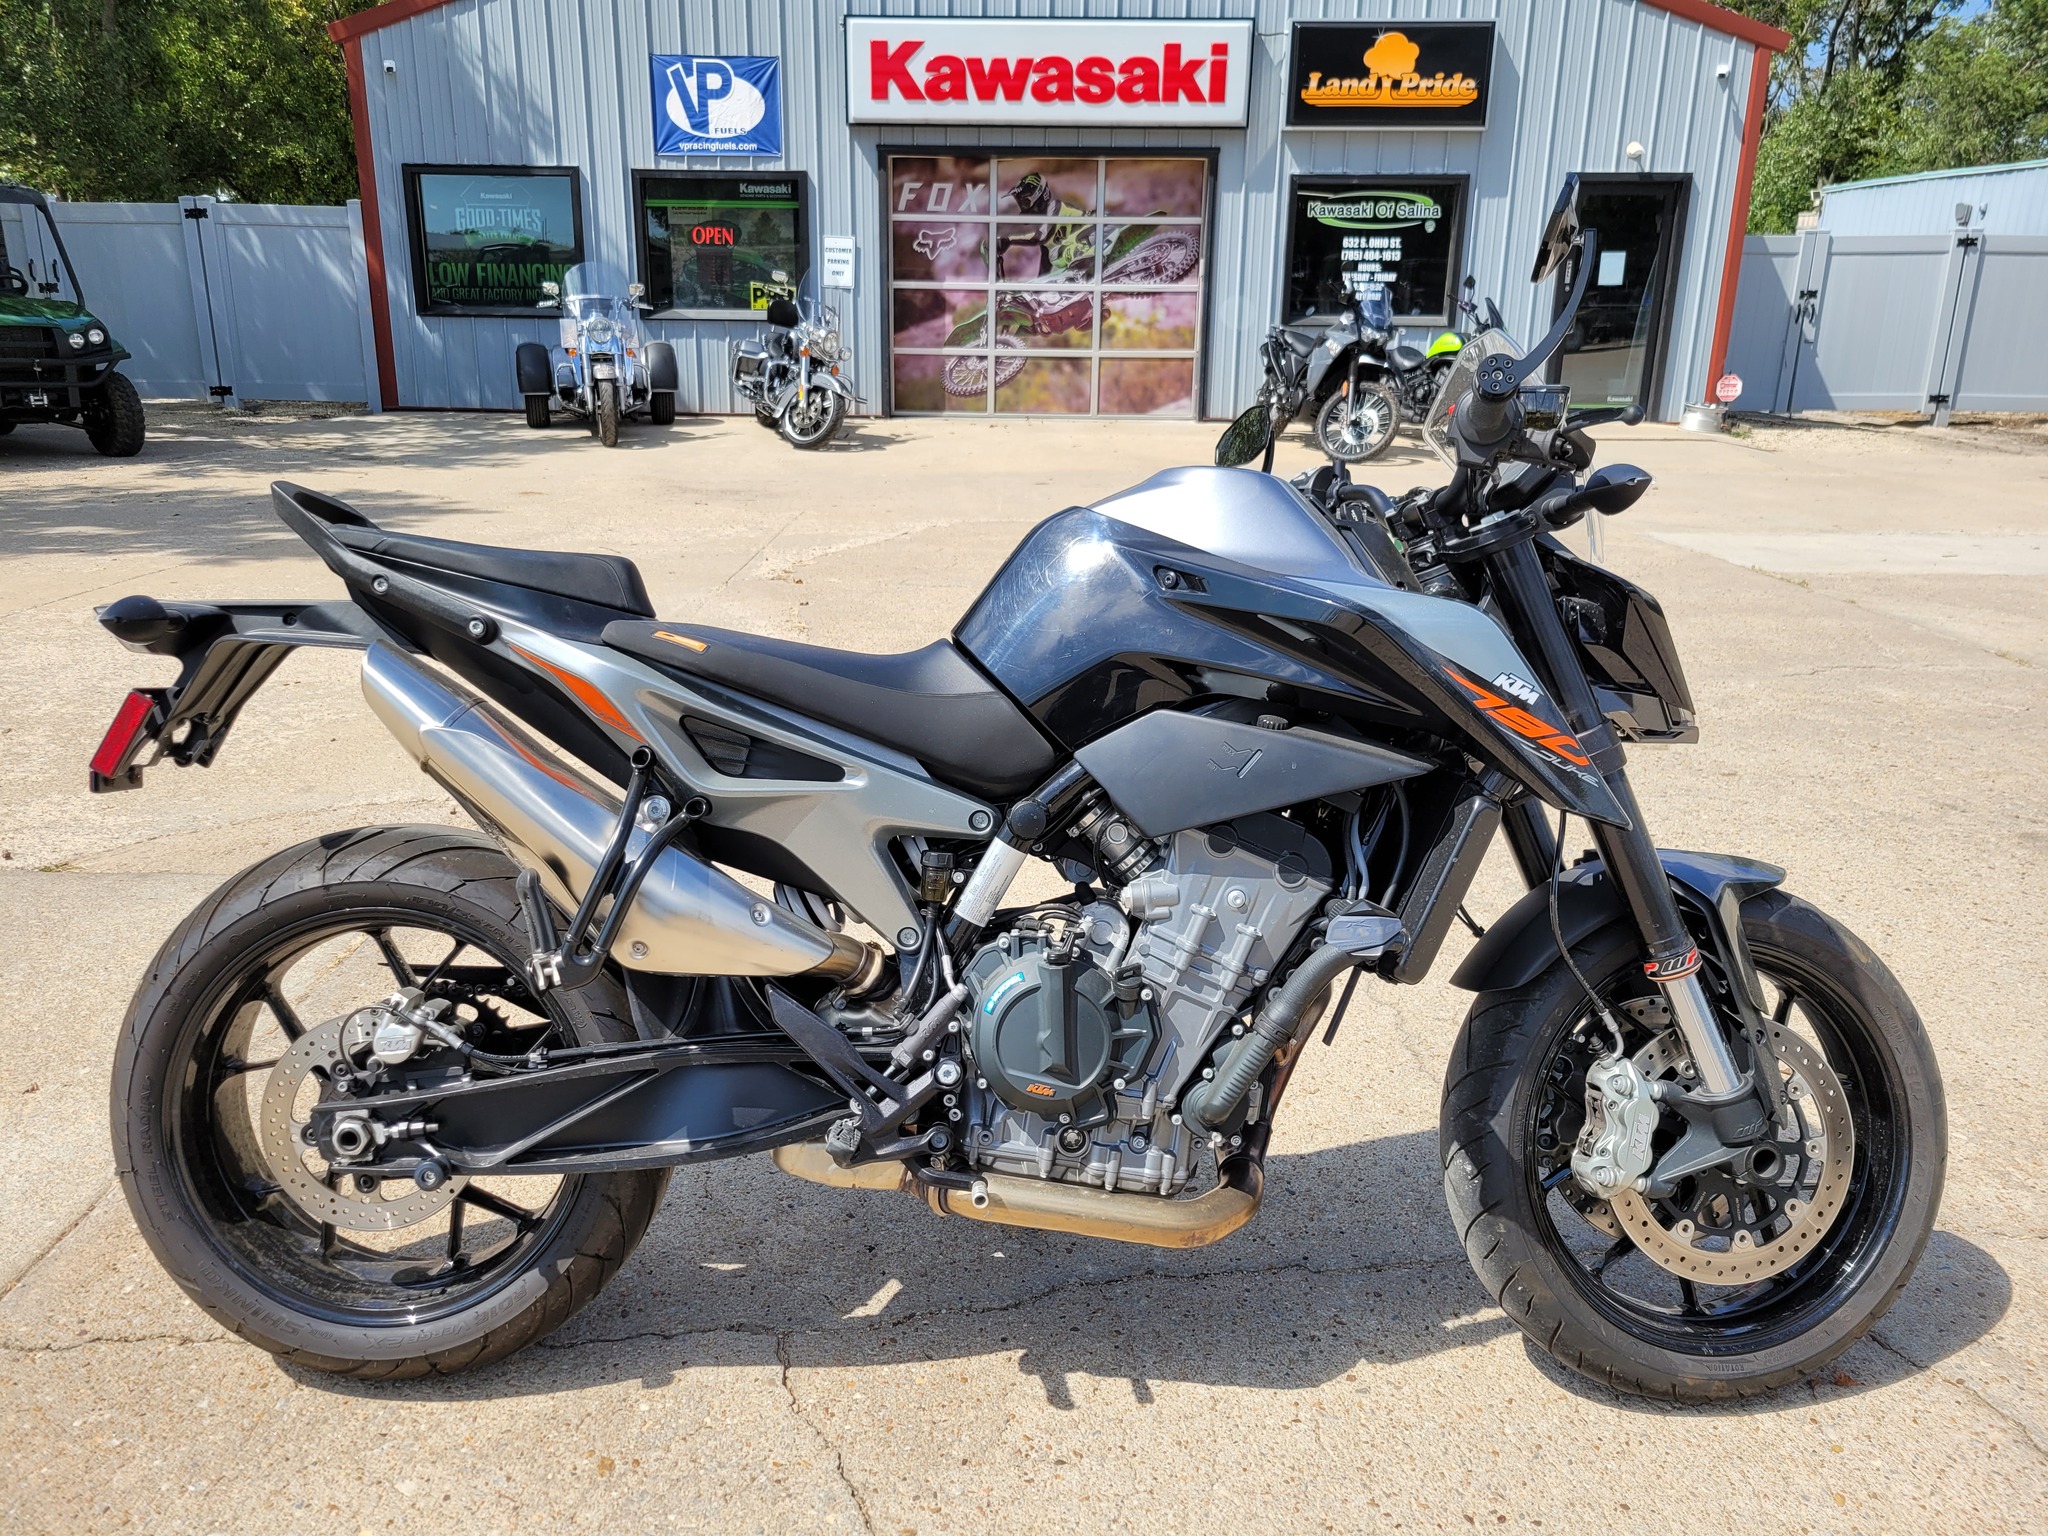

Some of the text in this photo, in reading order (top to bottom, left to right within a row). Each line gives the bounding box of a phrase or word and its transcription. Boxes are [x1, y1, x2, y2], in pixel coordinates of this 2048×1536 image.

[869, 39, 1229, 103] Kawasaki
[1305, 71, 1476, 97] Land Pride
[666, 58, 734, 135] VP
[679, 142, 758, 151] vpracingfuels.com
[480, 192, 513, 200] Kawasaki
[740, 183, 791, 194] Kawasaki
[898, 182, 986, 212] FOX
[455, 207, 542, 232] GOOD TIMES
[1308, 202, 1441, 218] Kawasaki Of Salina
[691, 226, 734, 245] OPEN
[1343, 236, 1359, 248] 632
[1369, 236, 1389, 248] OHIO
[1341, 249, 1402, 261] (785) 404-1613
[428, 262, 470, 288] LOW
[1374, 272, 1398, 282] FRIDAY
[452, 288, 481, 300] GREAT
[483, 288, 524, 300] FACTORY
[1491, 673, 1541, 706] KTM
[1441, 665, 1590, 766] 790
[1534, 750, 1600, 787] DUKE
[1026, 1083, 1056, 1097] KTM
[1630, 1113, 1650, 1161] KTM
